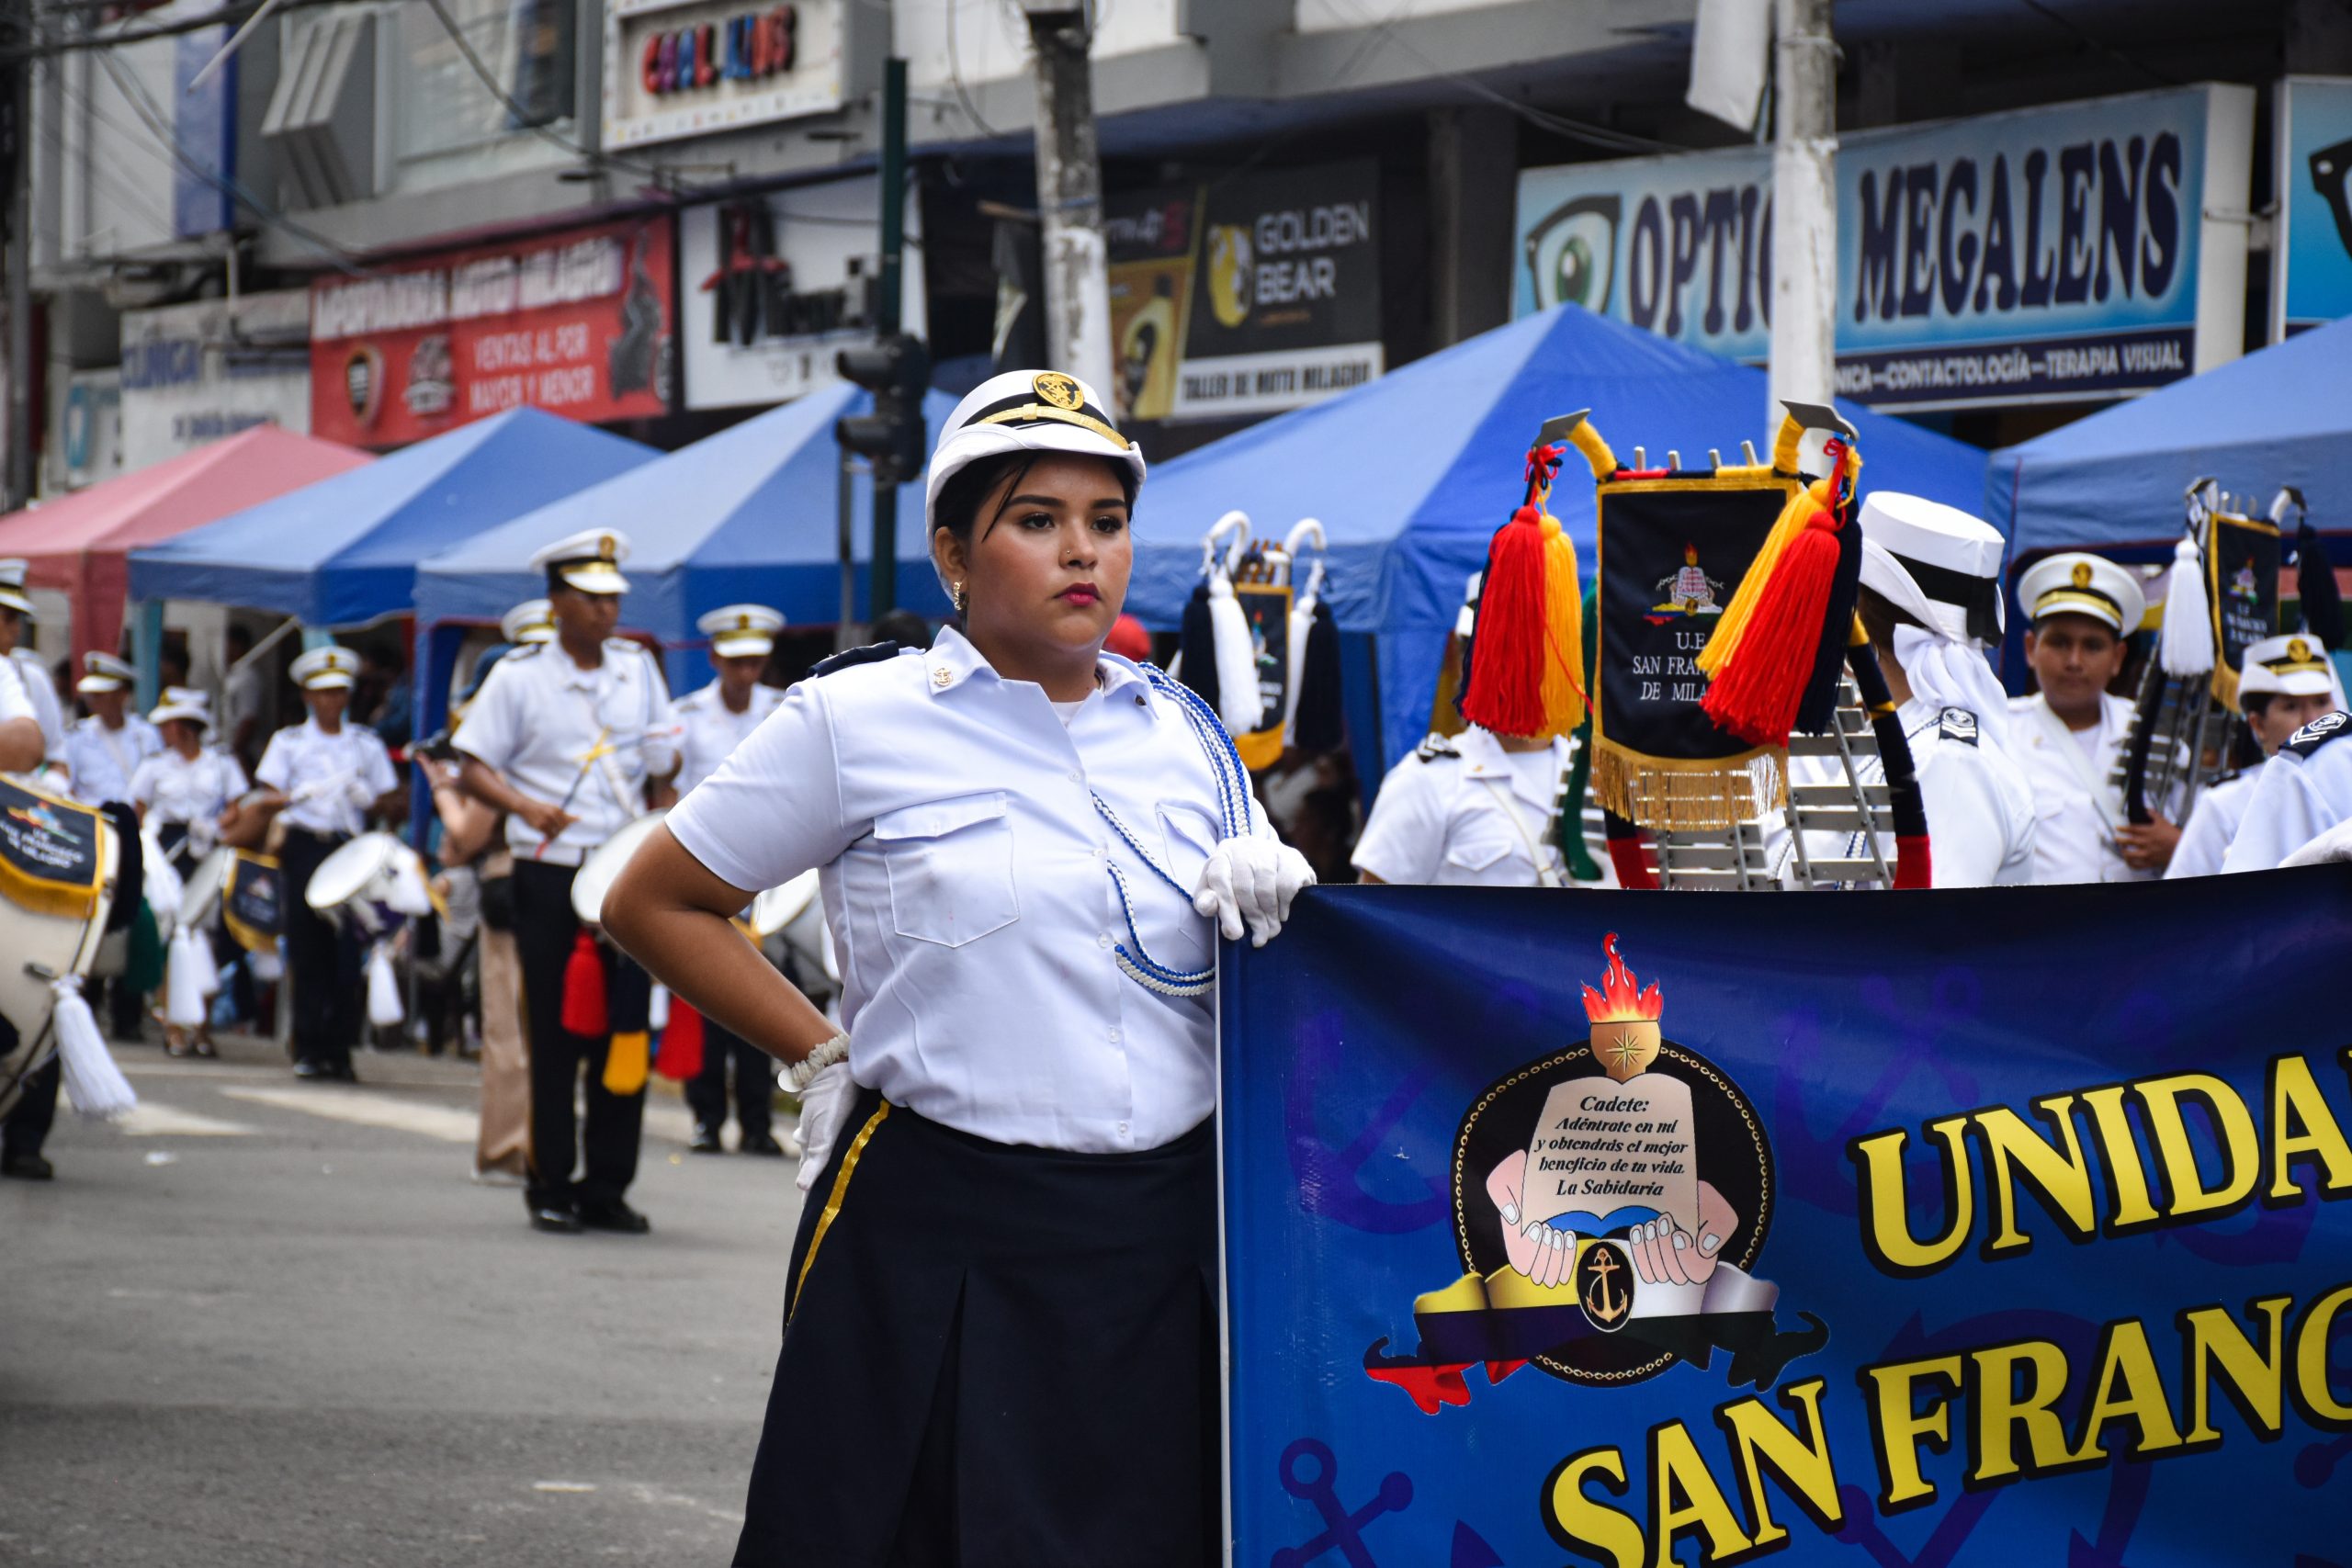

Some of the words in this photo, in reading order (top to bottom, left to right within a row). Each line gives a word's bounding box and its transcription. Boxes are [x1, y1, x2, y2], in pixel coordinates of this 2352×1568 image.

[1254, 199, 1370, 254] GOLDEN
[1630, 185, 1771, 338] OPTI
[1854, 130, 2182, 324] MEGALENS
[1254, 257, 1336, 305] BEAR
[2121, 341, 2185, 375] VISUAL
[1184, 373, 1228, 400] TALLER
[1235, 372, 1247, 397] DE
[1256, 368, 1295, 394] MOTO
[1633, 655, 1661, 674] SAN
[1640, 681, 1662, 700] DE
[1579, 1095, 1650, 1112] Cadete:
[1634, 1121, 1653, 1134] en
[1534, 1138, 1546, 1153] y
[1548, 1136, 1624, 1153] obtendrás
[1626, 1139, 1642, 1154] el
[1643, 1140, 1690, 1157] mejor
[1857, 1050, 2352, 1269] UNIDA
[1539, 1156, 1608, 1175] beneficio
[1611, 1158, 1629, 1173] de
[1631, 1161, 1647, 1173] tu
[1651, 1160, 1686, 1175] vida.
[1555, 1179, 1577, 1196] La
[1551, 1380, 1843, 1568] SAN
